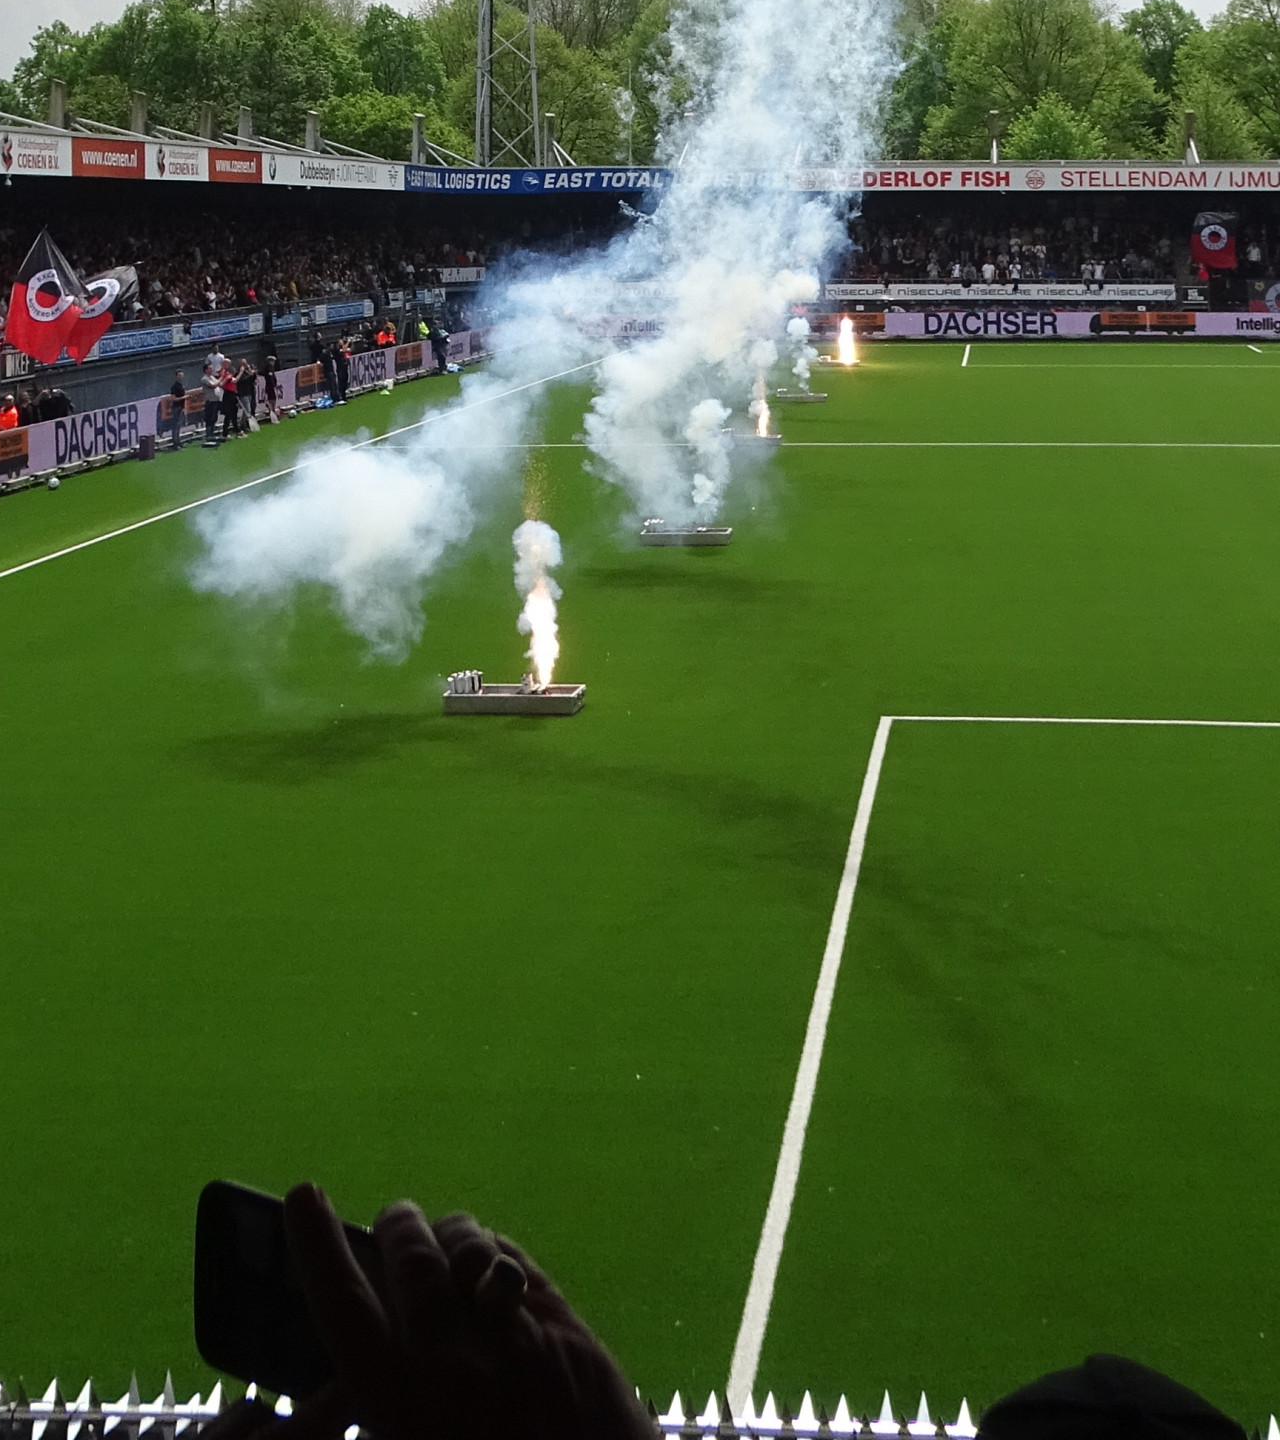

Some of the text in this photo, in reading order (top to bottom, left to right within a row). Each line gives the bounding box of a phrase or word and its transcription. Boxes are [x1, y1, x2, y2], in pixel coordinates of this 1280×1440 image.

[18, 154, 46, 169] COENEN
[82, 149, 137, 168] www.coenen.nl
[216, 157, 256, 173] www.coenen.nl
[445, 172, 511, 190] LOGISTICS
[544, 172, 596, 189] EAST
[601, 171, 663, 189] TOTAL
[961, 171, 1010, 187] FISH
[1061, 171, 1207, 188] STELLENDAM
[924, 313, 1058, 335] DACHSER
[55, 404, 138, 462] DACHSER
